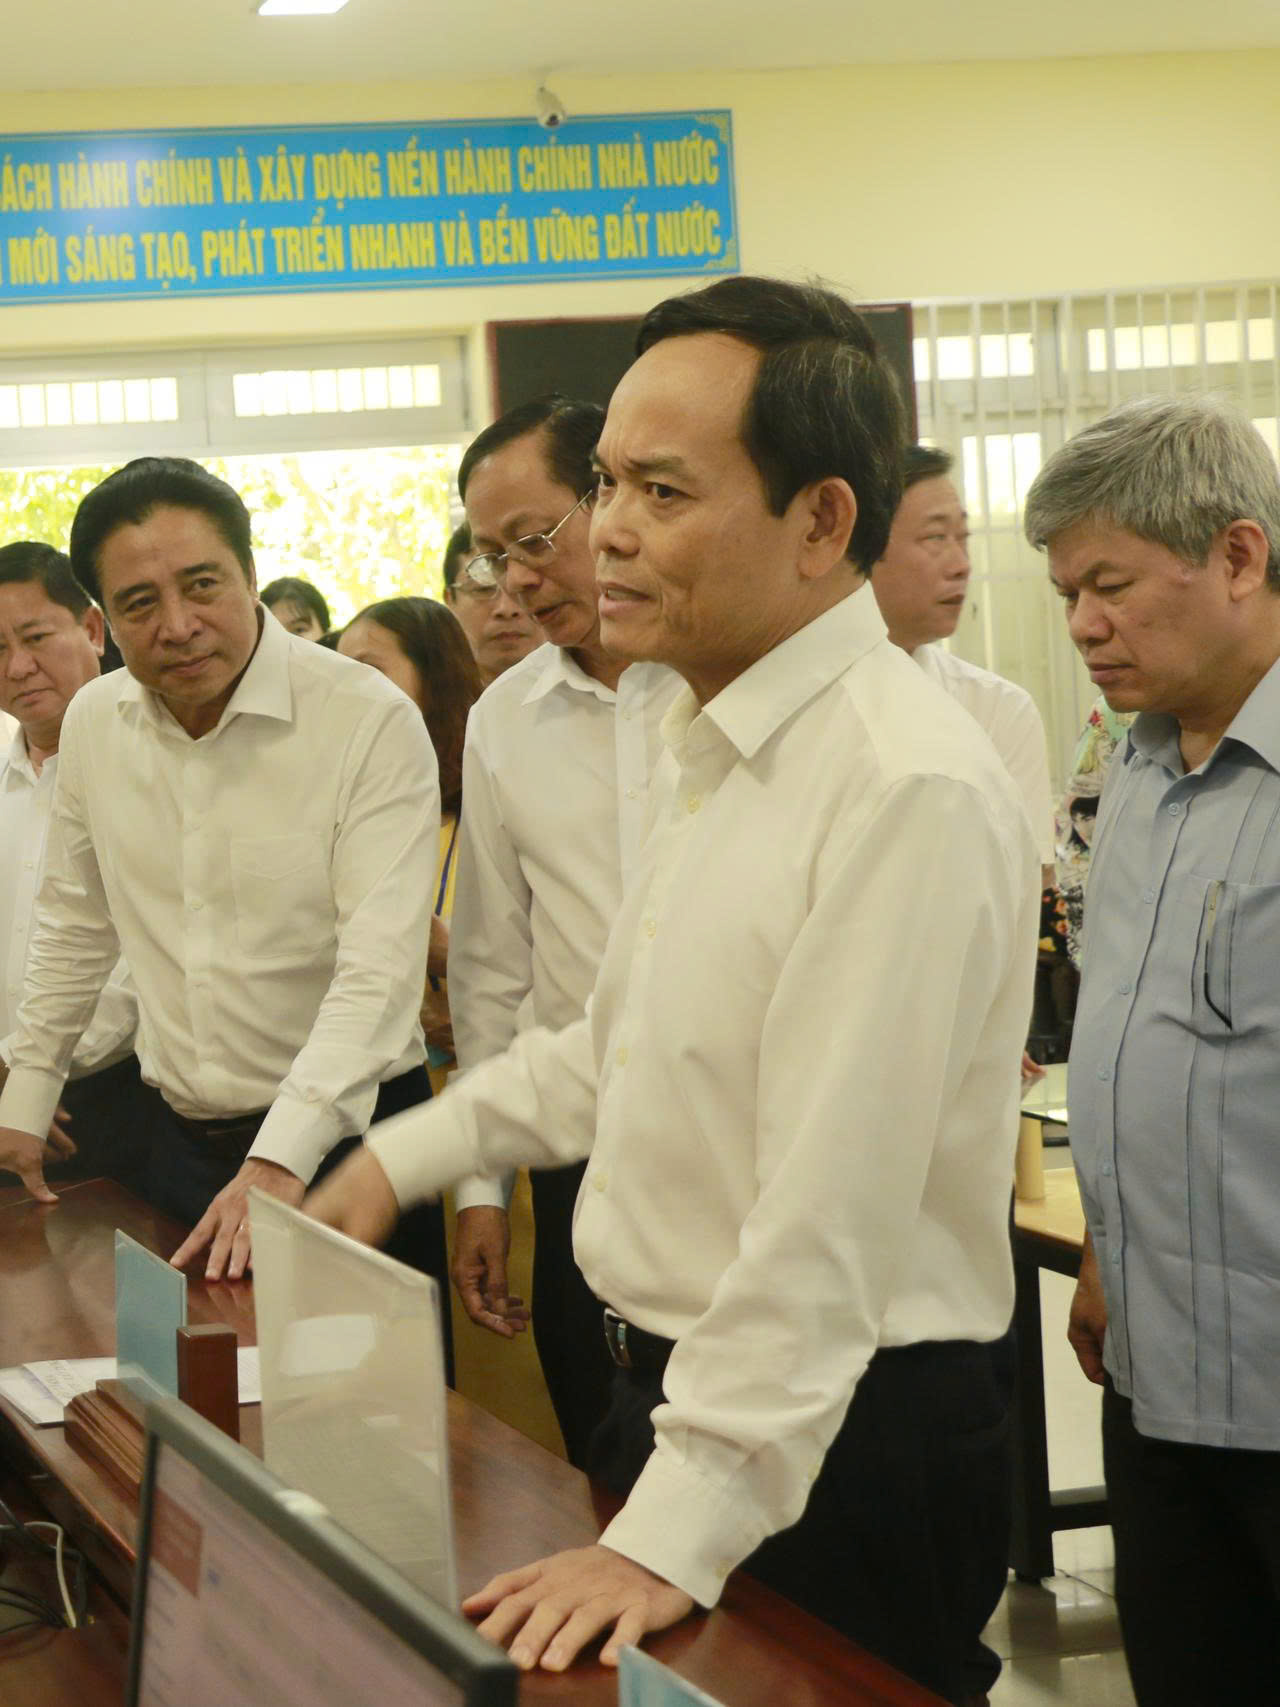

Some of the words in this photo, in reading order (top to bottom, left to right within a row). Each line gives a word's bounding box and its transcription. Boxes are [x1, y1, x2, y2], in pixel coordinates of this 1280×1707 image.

[58, 152, 130, 208] HÀNH
[136, 149, 213, 208] CHÍNH
[219, 148, 253, 203] VÀ
[258, 145, 306, 201] XÂY
[312, 149, 382, 211] DỰNG
[444, 140, 512, 194] HÀNH
[518, 136, 592, 192] CHÍNH
[598, 133, 648, 188] NHÀ
[654, 130, 719, 186] NƯỚC
[8, 228, 59, 284] MỚI
[65, 224, 136, 283] SÁNG
[140, 232, 197, 289] TẠO,
[202, 221, 264, 276] PHÁT
[272, 206, 344, 272] TRIỂN
[350, 222, 436, 269] NHANH
[440, 212, 474, 266] VÀ
[533, 208, 600, 262] VỮNG
[605, 199, 649, 259] ĐẤT
[656, 202, 721, 256] NƯỚC
